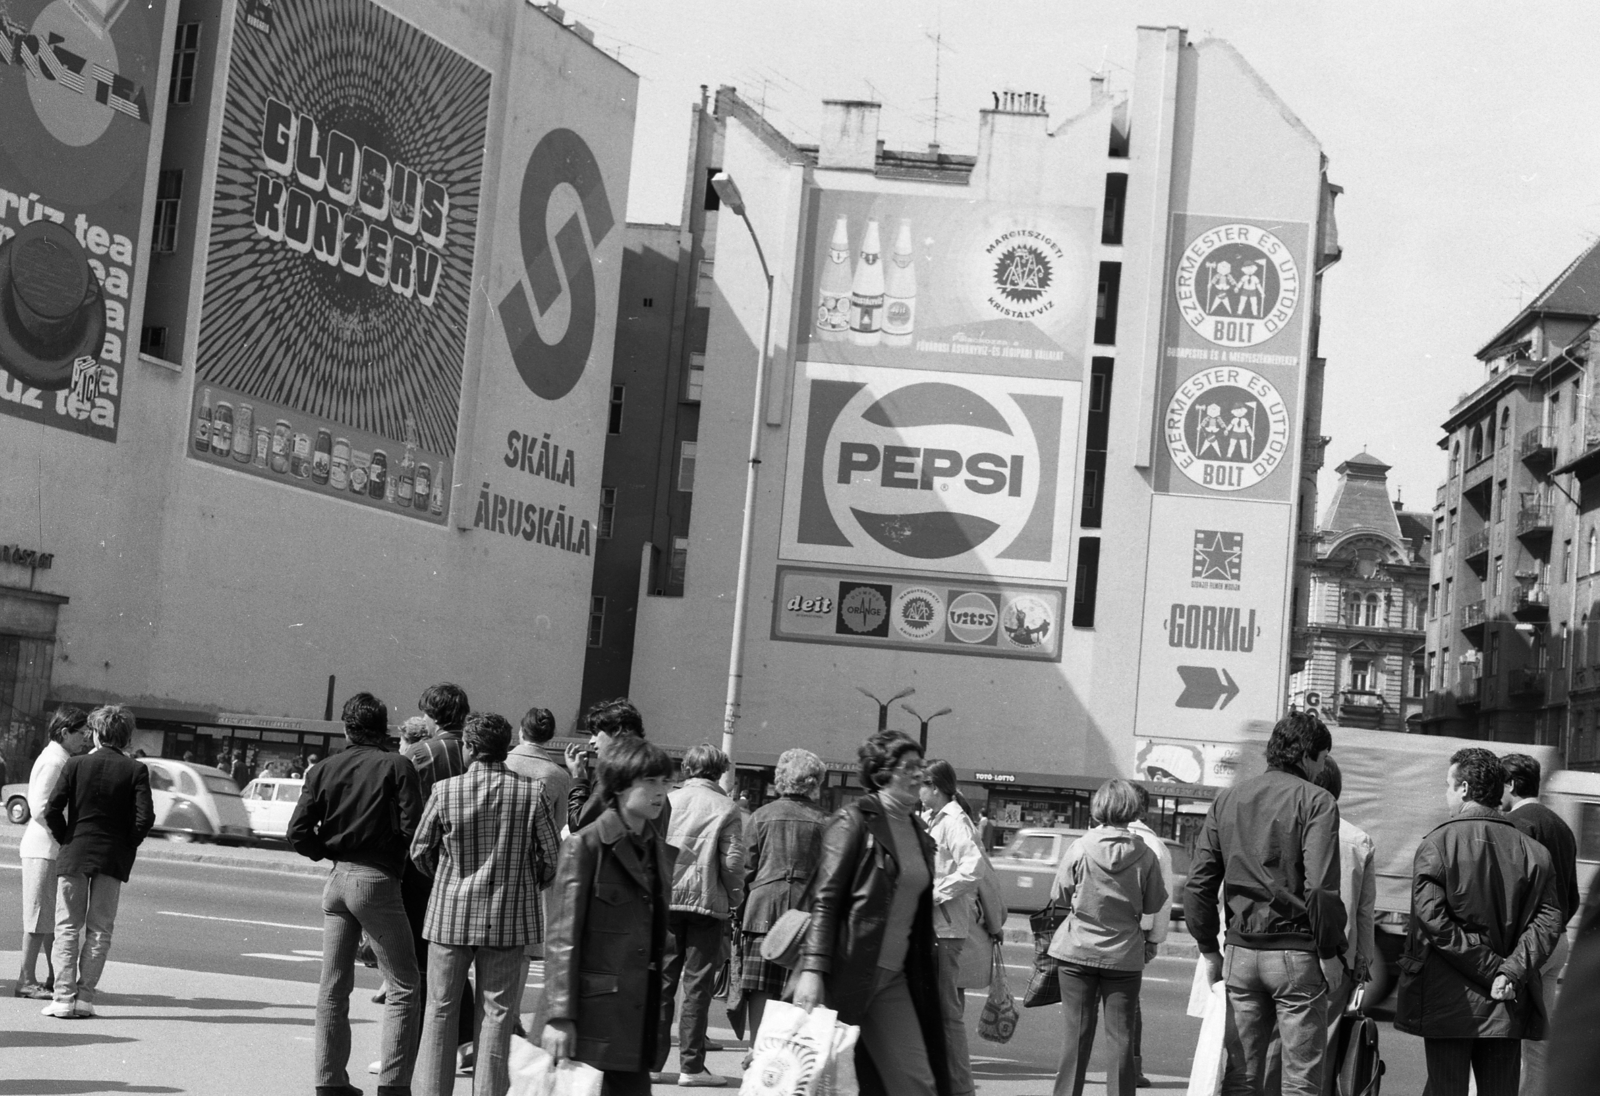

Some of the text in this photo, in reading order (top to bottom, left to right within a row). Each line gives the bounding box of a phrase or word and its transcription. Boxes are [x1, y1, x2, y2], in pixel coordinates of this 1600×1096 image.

[262, 97, 449, 249] GLOBUS
[75, 214, 133, 267] tea
[254, 173, 442, 307] KONZERV
[985, 230, 1064, 258] MARGITSZIGETI
[1178, 227, 1249, 327] EZERMESTER
[1213, 320, 1255, 343] BOLT
[1221, 351, 1227, 361] A
[1168, 369, 1239, 470] EZERMESTER
[503, 429, 575, 488] SKÁLA
[837, 441, 1024, 498] PEPSI
[1203, 463, 1244, 487] BOLT
[473, 481, 591, 556] ÁRUSKÁLA
[787, 595, 832, 614] deit
[847, 597, 882, 627] ORANGE
[1168, 603, 1256, 653] GORKIJ
